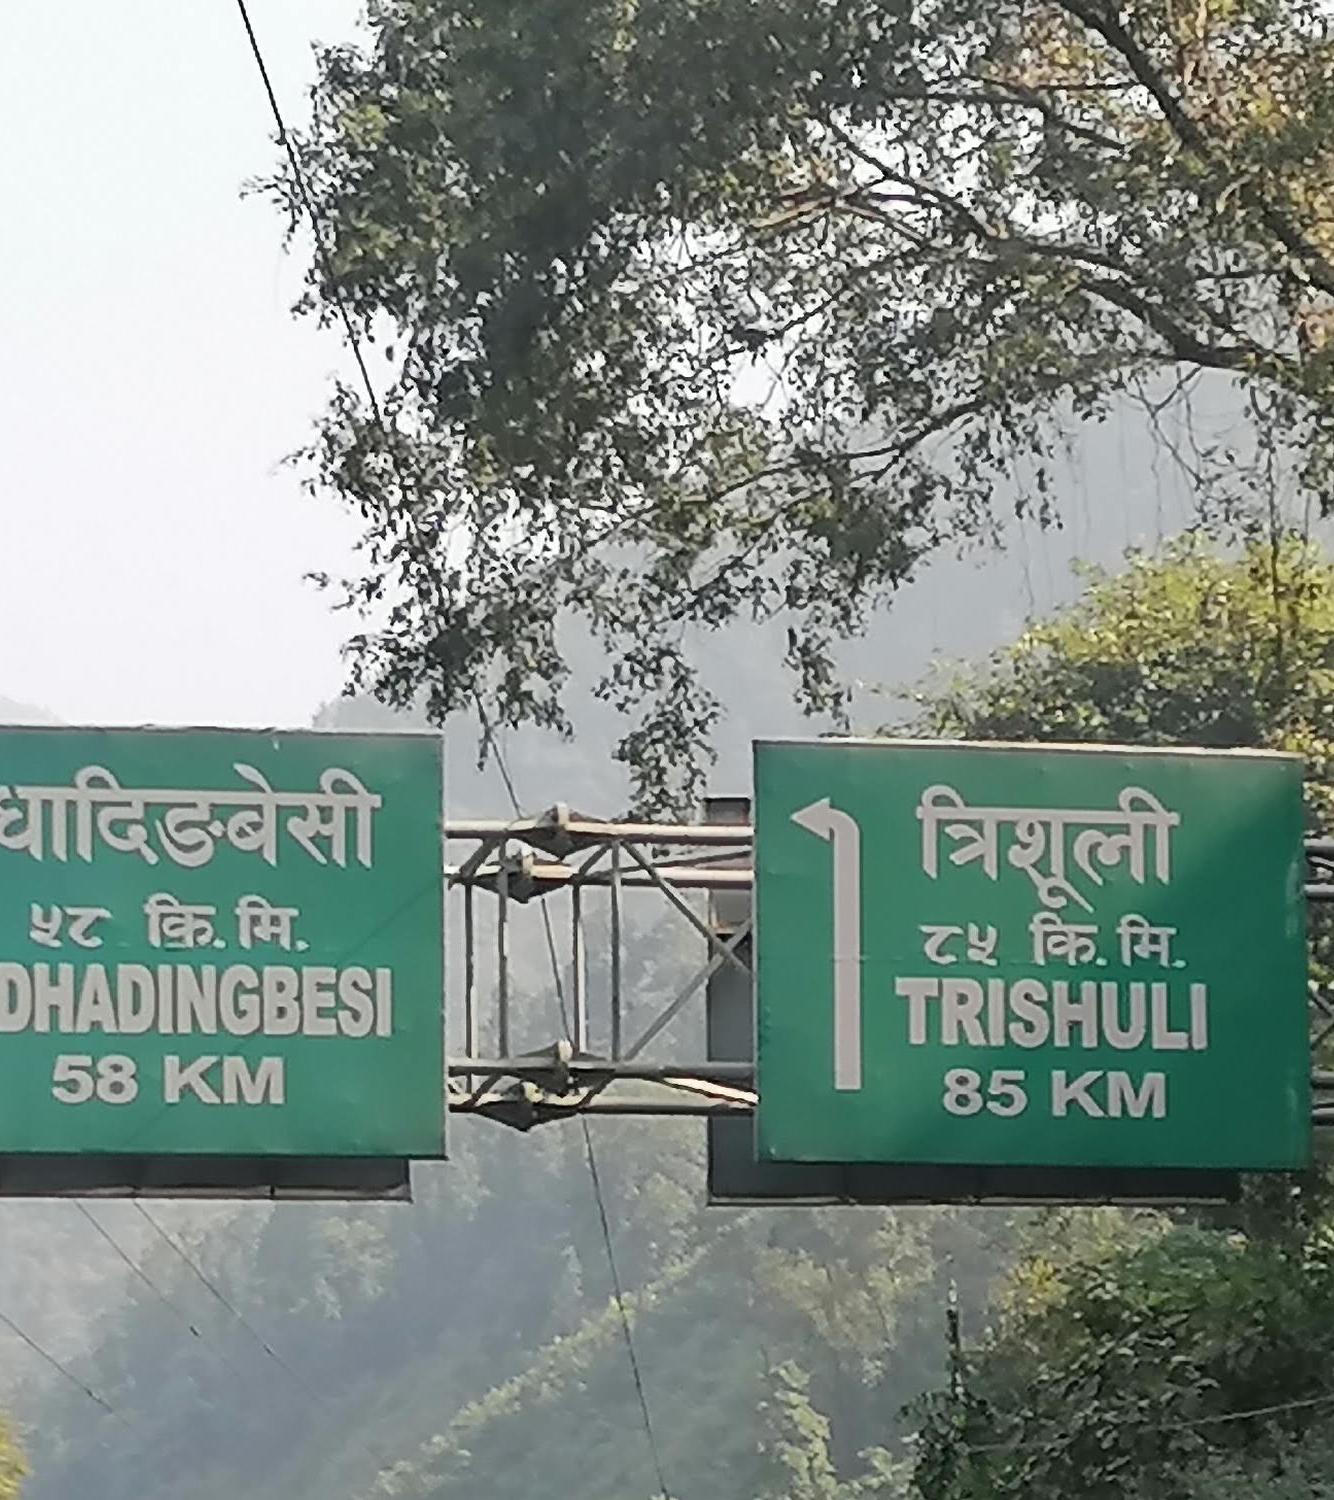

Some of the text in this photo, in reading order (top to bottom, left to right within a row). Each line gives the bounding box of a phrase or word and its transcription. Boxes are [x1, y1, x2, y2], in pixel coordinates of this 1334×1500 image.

[915, 784, 1182, 912] त्रिशूली
[28, 903, 113, 949] ५८
[919, 922, 999, 967] ८५
[894, 976, 1208, 1050] TRISHULI
[51, 1053, 286, 1106] 58 KM
[942, 1068, 1166, 1118] 85 KM
